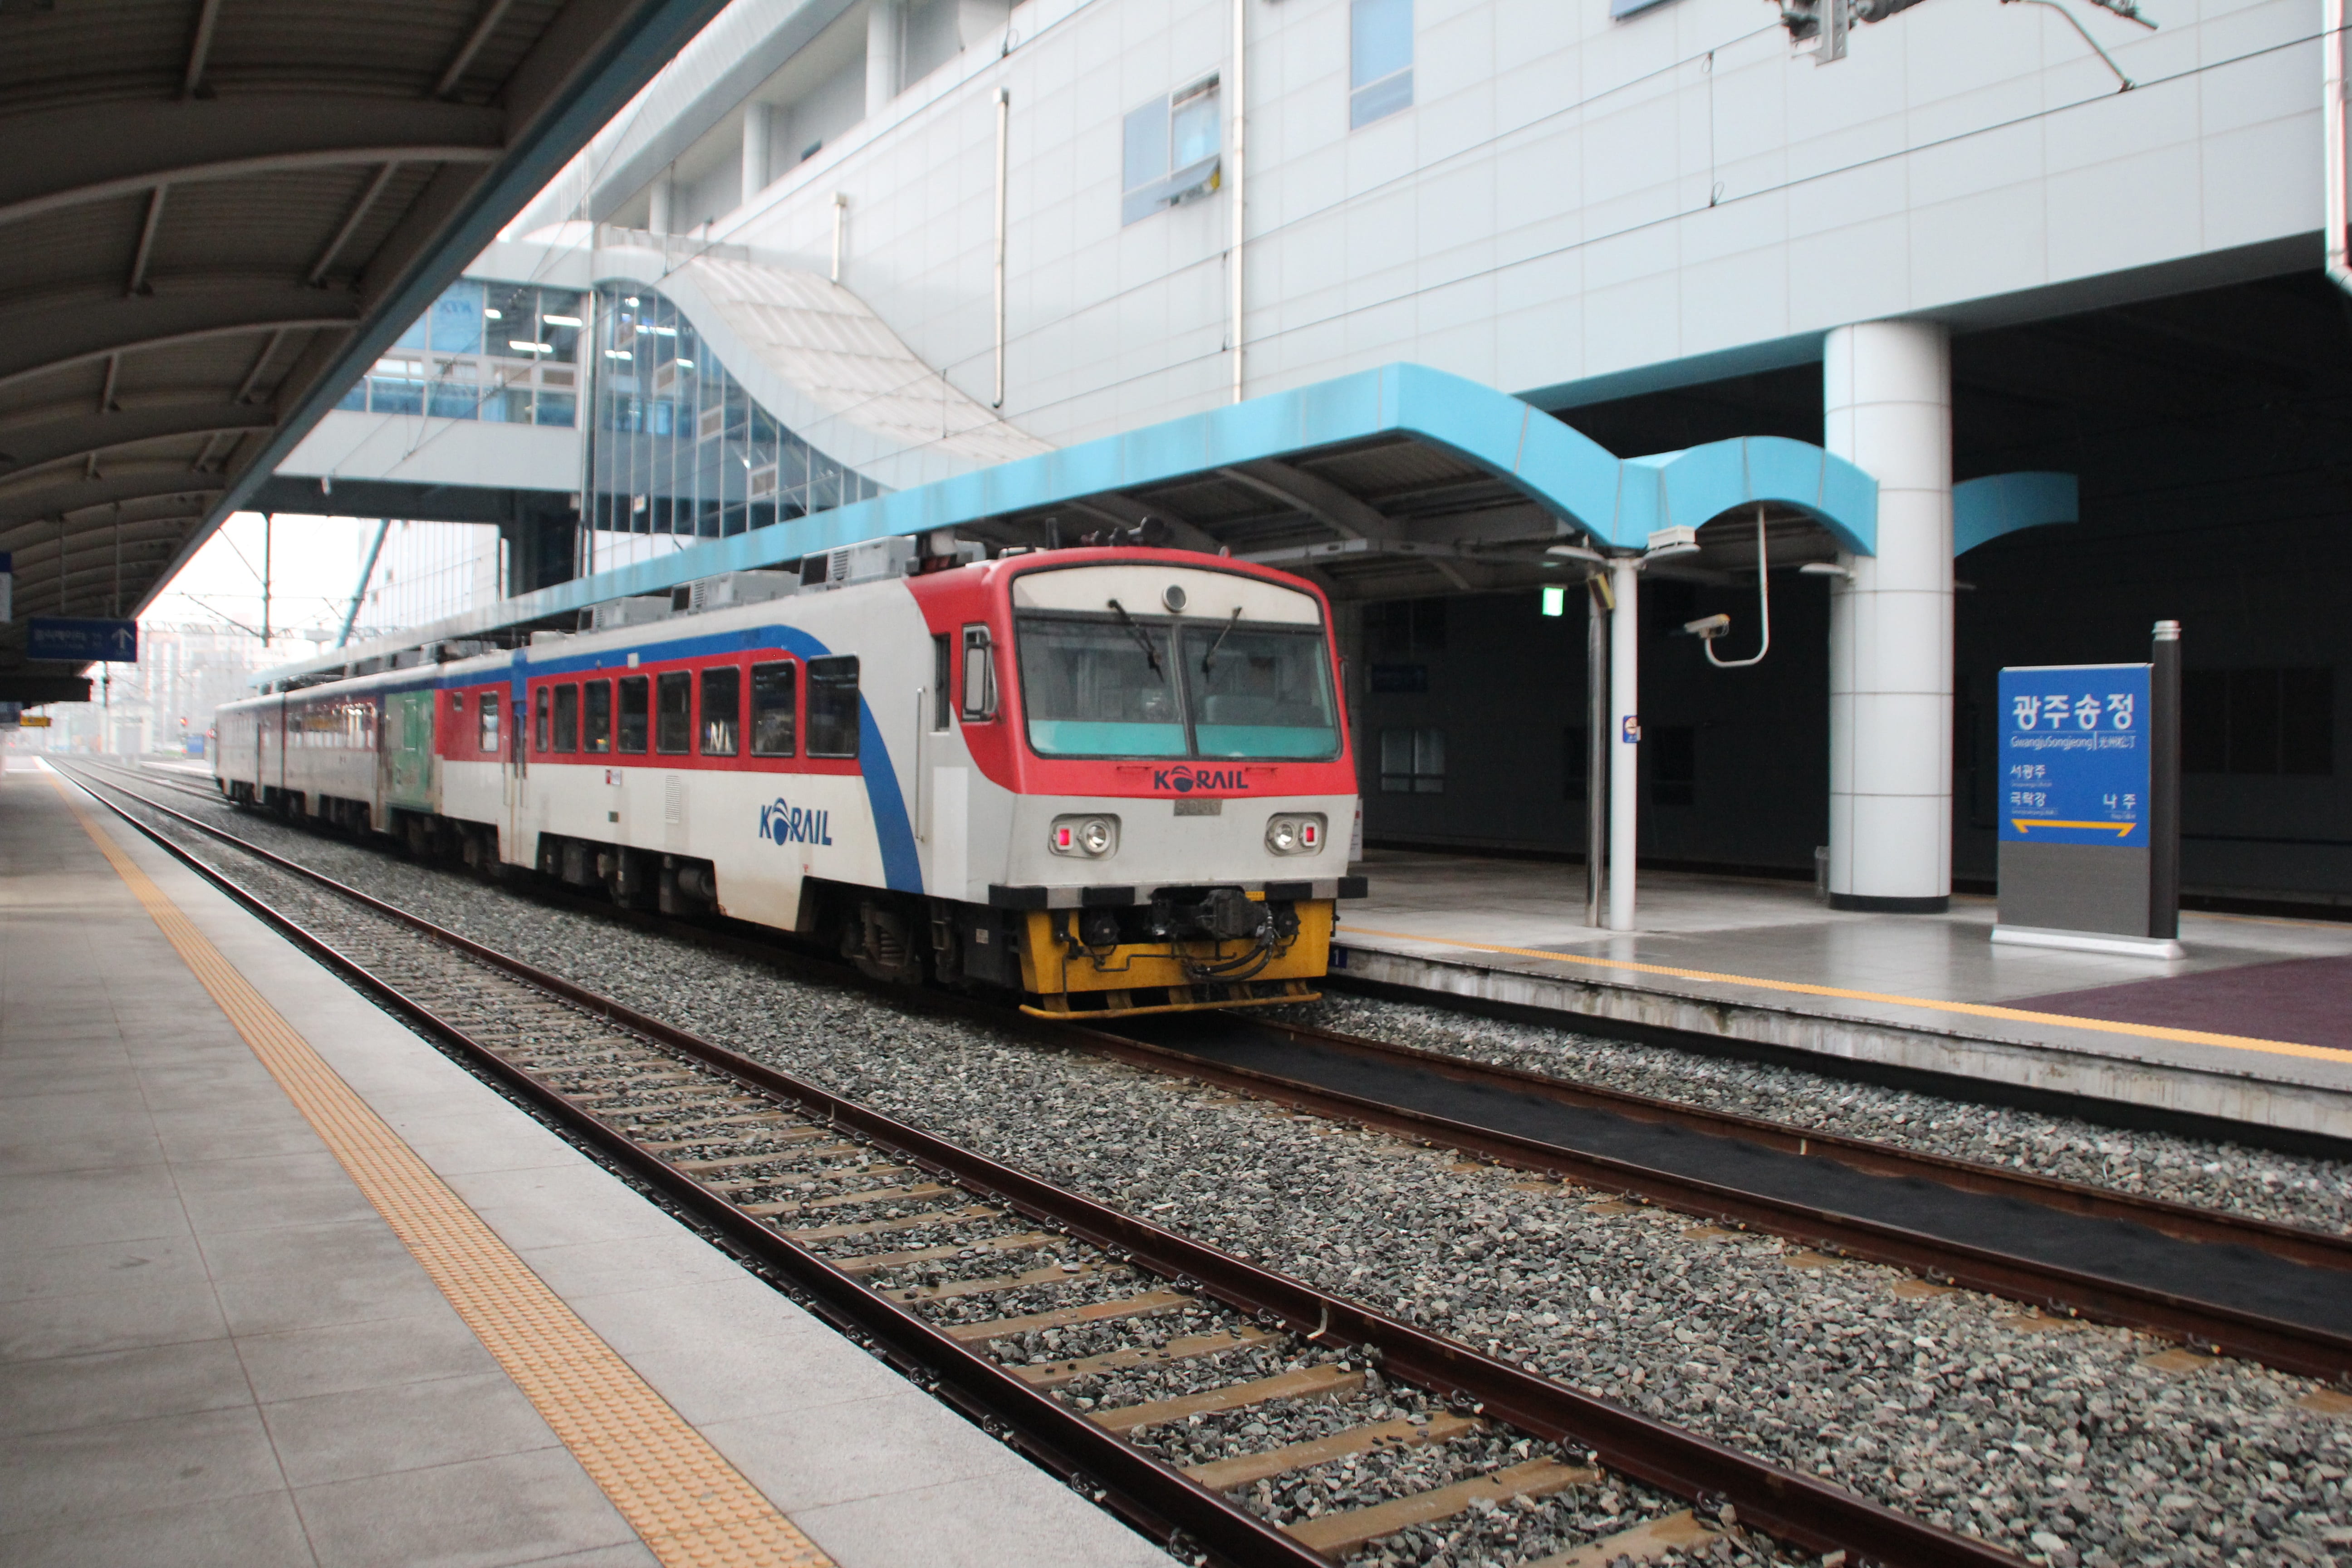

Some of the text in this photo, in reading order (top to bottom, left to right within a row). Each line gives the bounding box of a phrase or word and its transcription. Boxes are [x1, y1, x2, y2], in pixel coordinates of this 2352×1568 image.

[2013, 694, 2135, 730] 광주송정
[2011, 736, 2093, 750] GwangjuSongjeong
[1154, 765, 1248, 792] KORAIL
[2010, 764, 2046, 779] 서광주
[2010, 792, 2047, 807] 극락강
[759, 797, 832, 846] KORAIL
